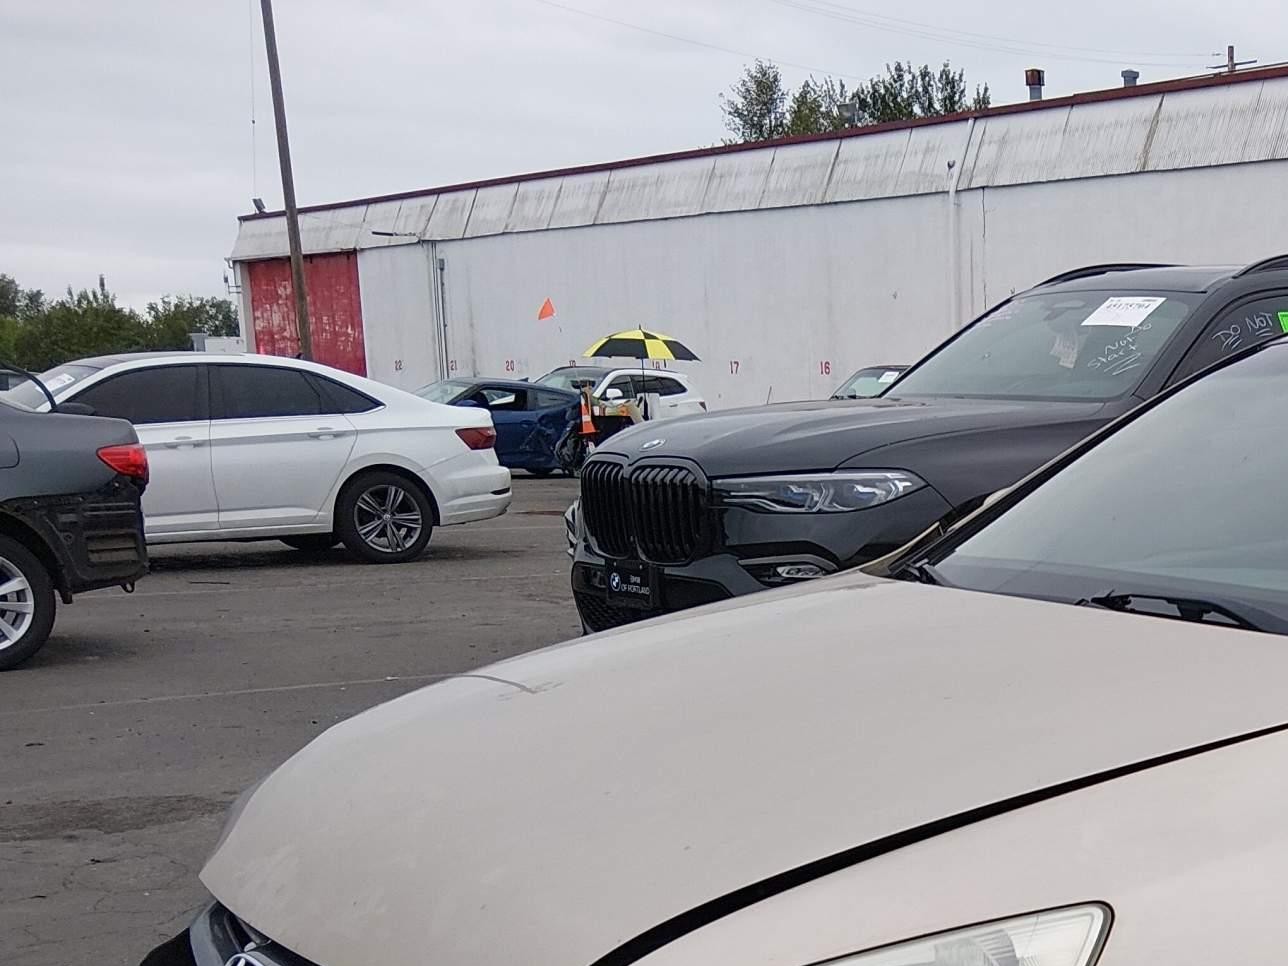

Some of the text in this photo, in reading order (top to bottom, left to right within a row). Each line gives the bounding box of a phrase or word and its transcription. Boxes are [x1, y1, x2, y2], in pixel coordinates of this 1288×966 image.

[449, 359, 459, 371] 21
[505, 359, 515, 372] 20
[729, 360, 740, 375] 17
[819, 360, 831, 376] 16
